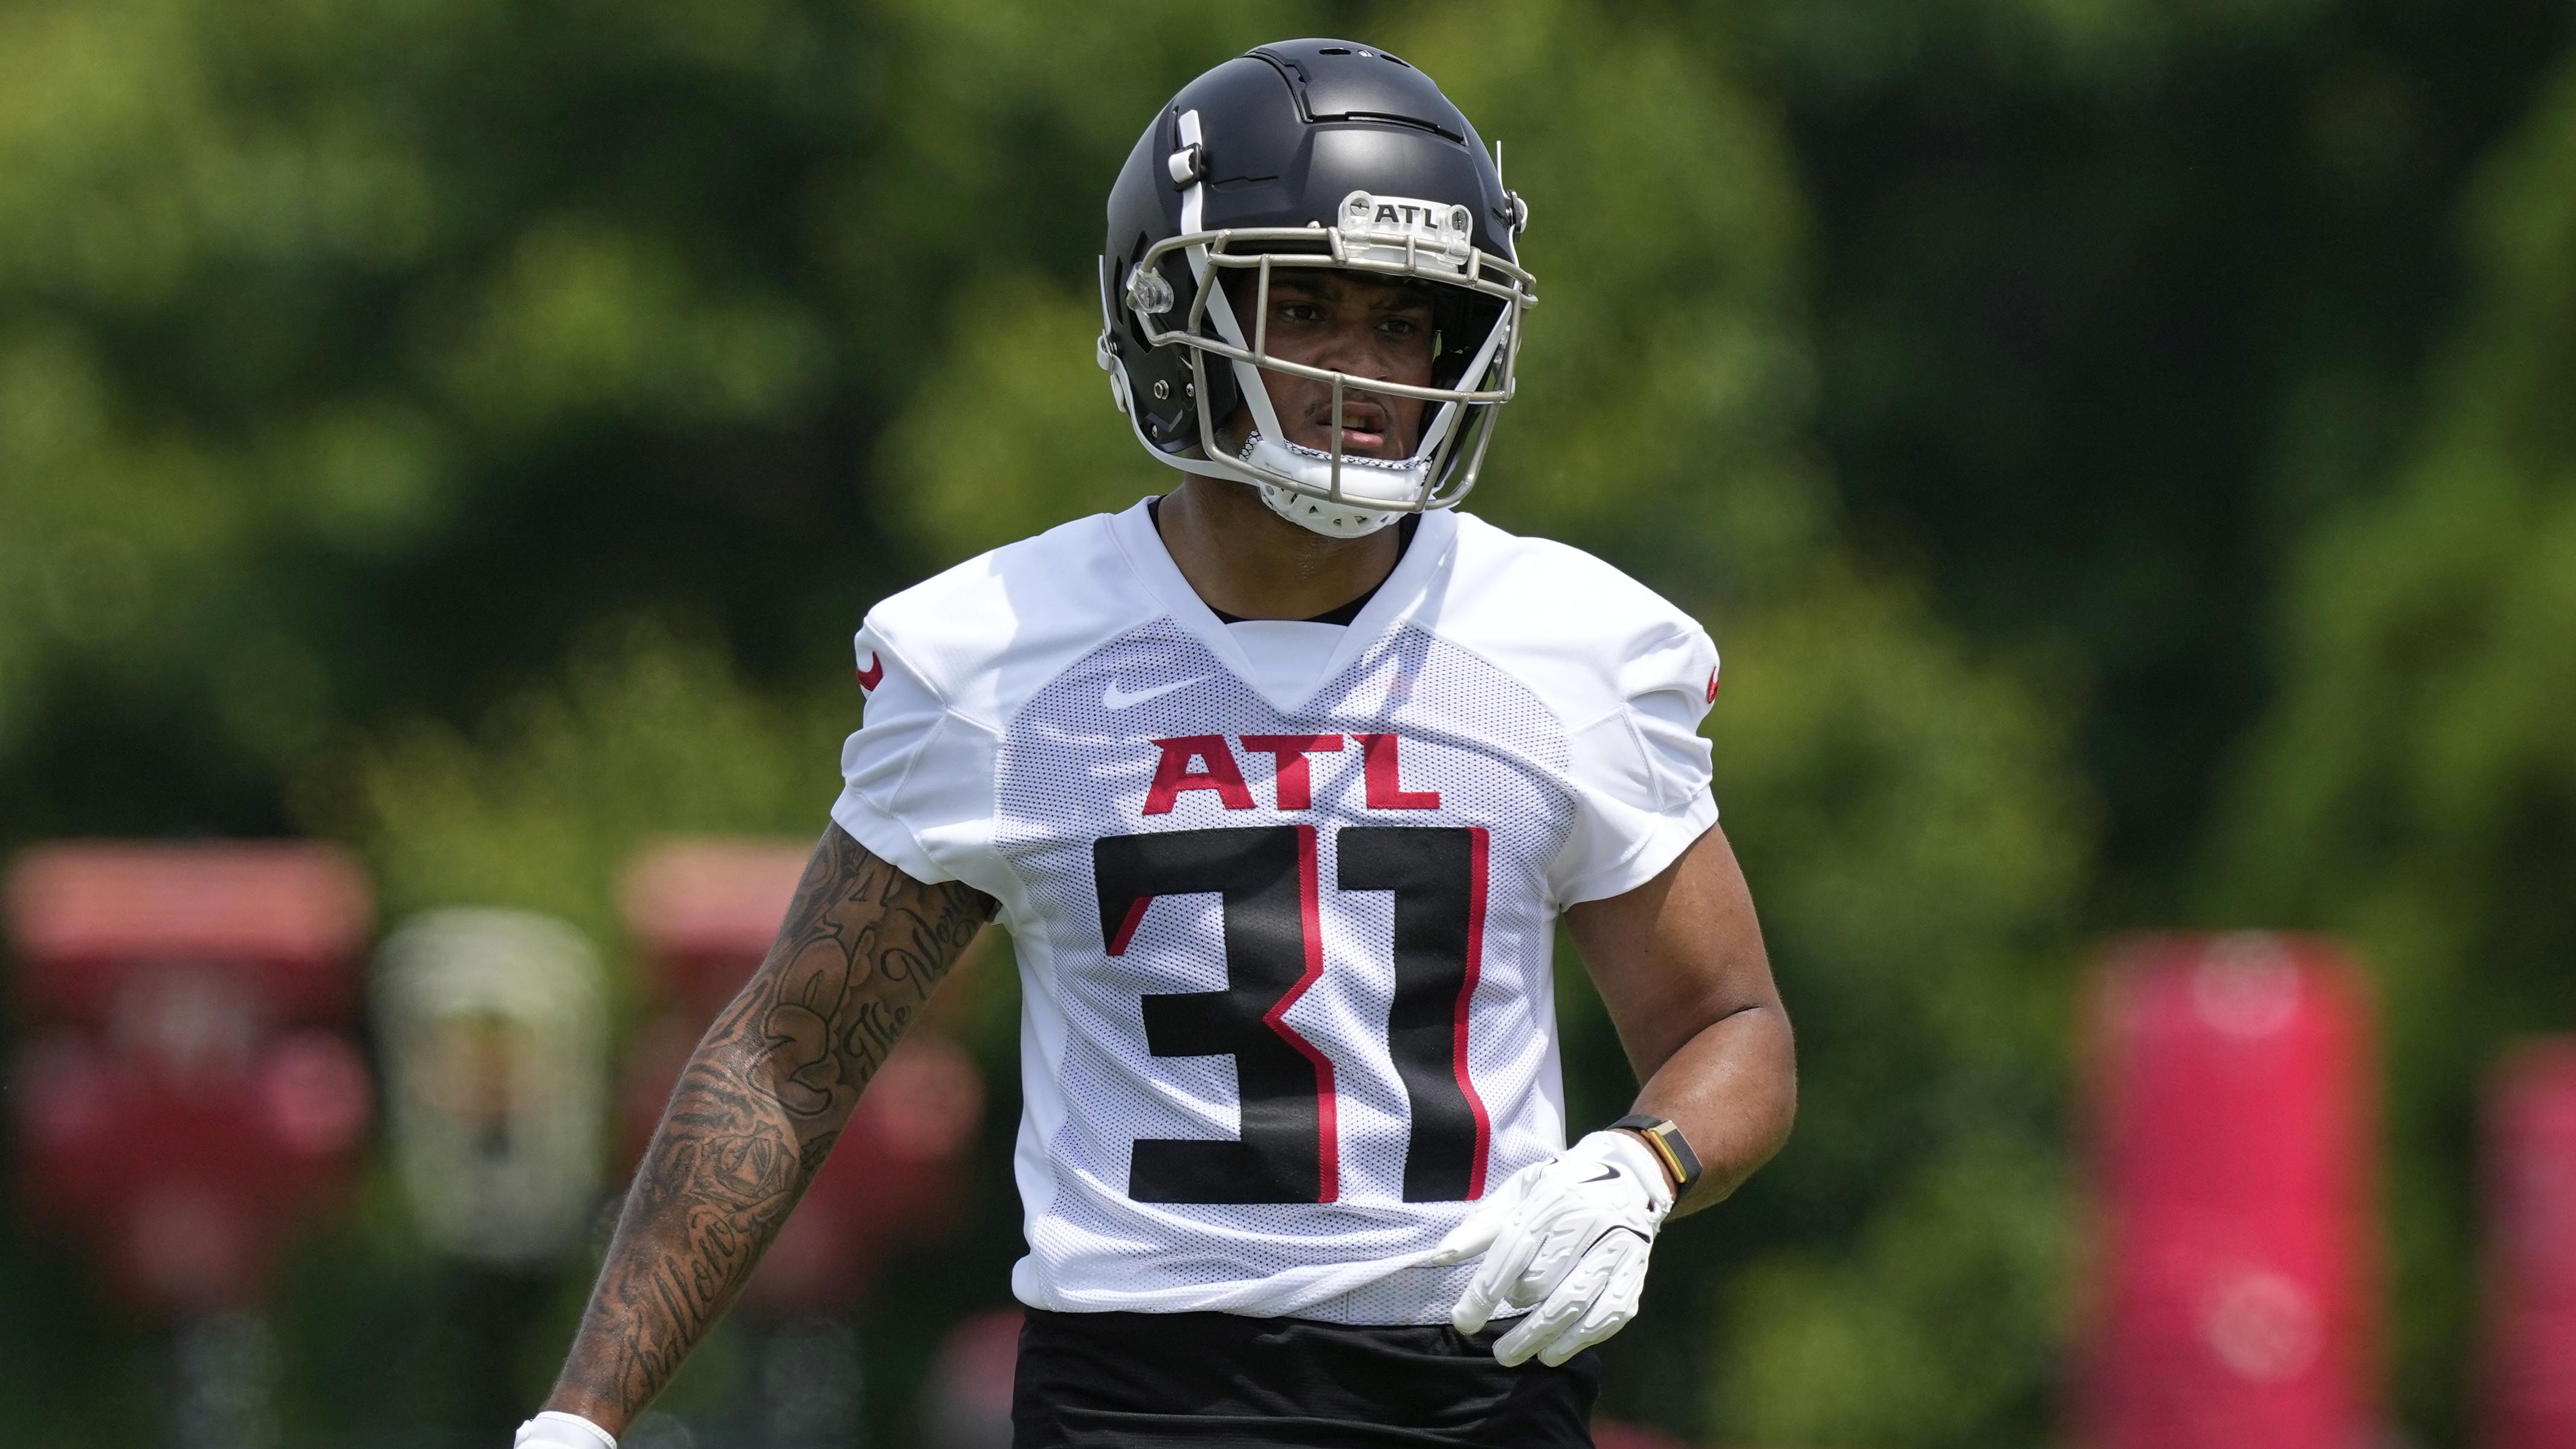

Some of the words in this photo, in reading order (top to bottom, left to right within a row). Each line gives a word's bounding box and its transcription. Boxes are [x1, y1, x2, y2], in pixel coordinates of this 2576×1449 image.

[1374, 204, 1438, 229] ATL
[1141, 734, 1441, 816] ATL
[843, 1001, 911, 1083] The
[1093, 824, 1490, 1204] 31
